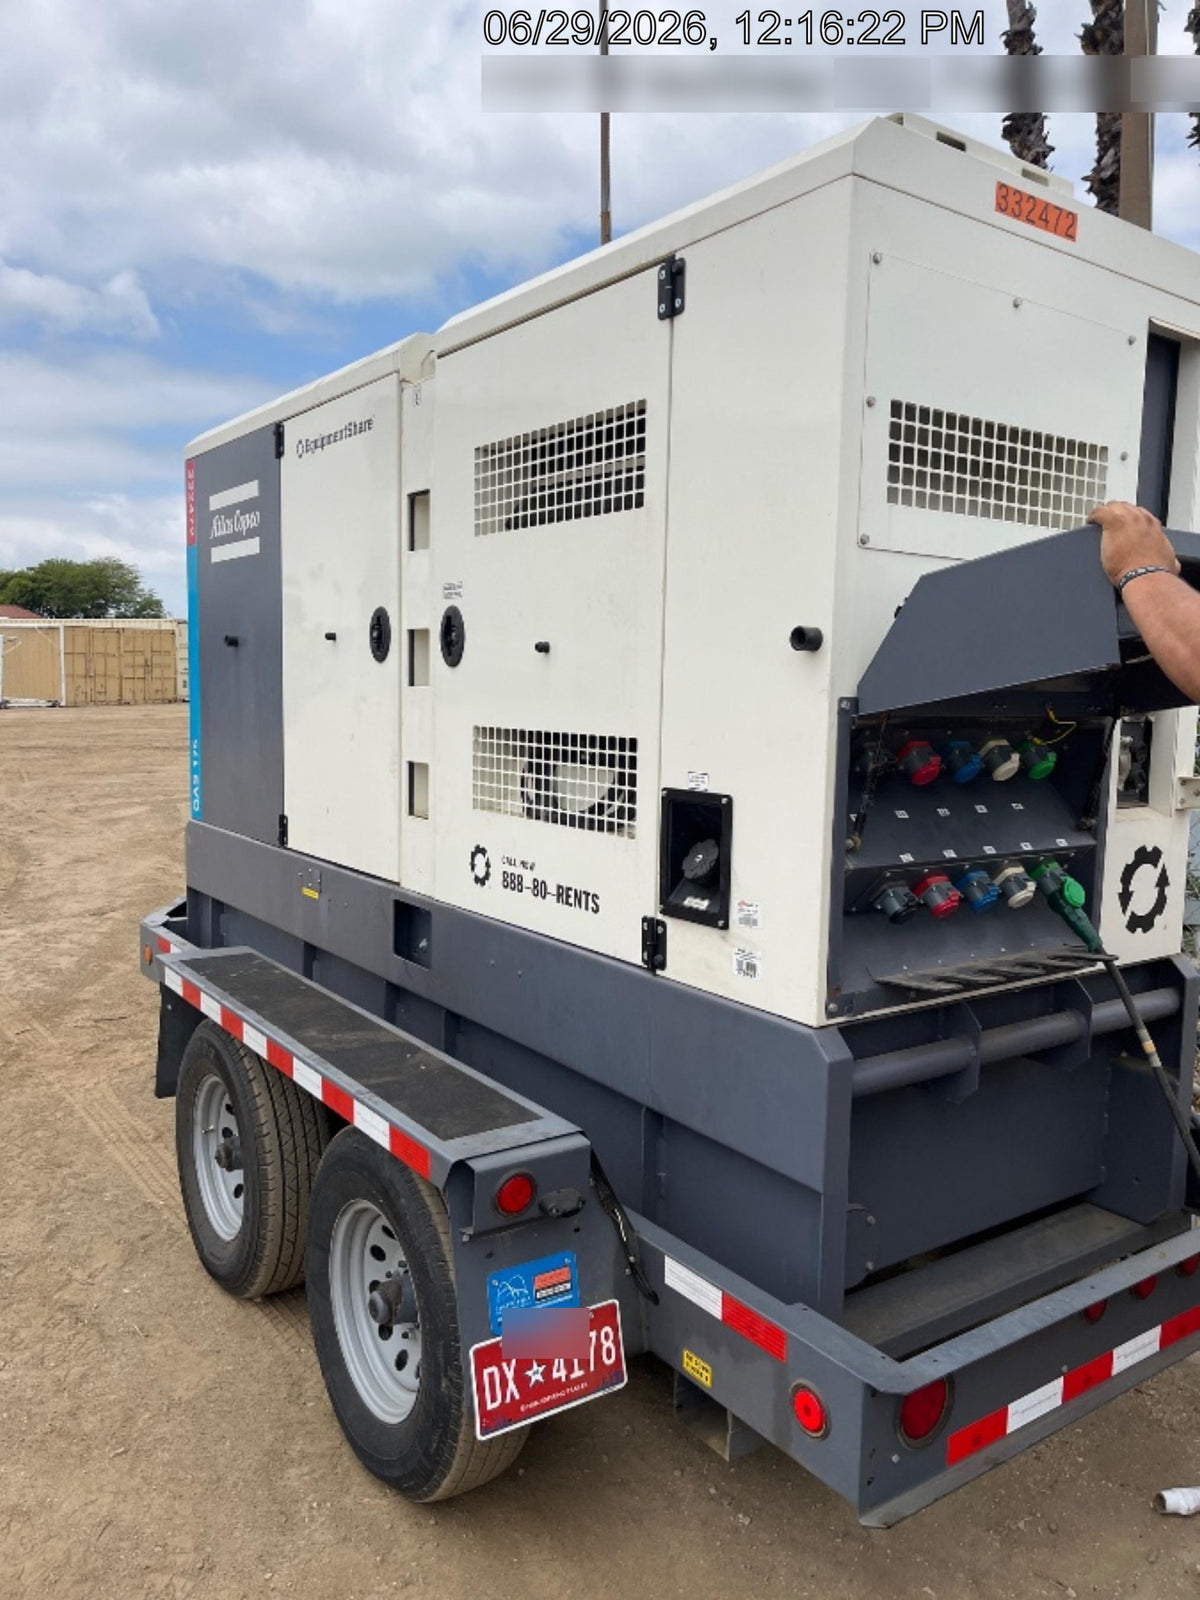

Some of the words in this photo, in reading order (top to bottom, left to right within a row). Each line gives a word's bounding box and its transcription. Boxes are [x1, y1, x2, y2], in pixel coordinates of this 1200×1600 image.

[997, 182, 1076, 240] 332472
[305, 417, 373, 454] EquipmentShare
[209, 514, 233, 540] Atlas
[234, 509, 260, 536] Copco
[502, 870, 600, 914] 888-80-RENTS
[482, 1358, 520, 1411] DX
